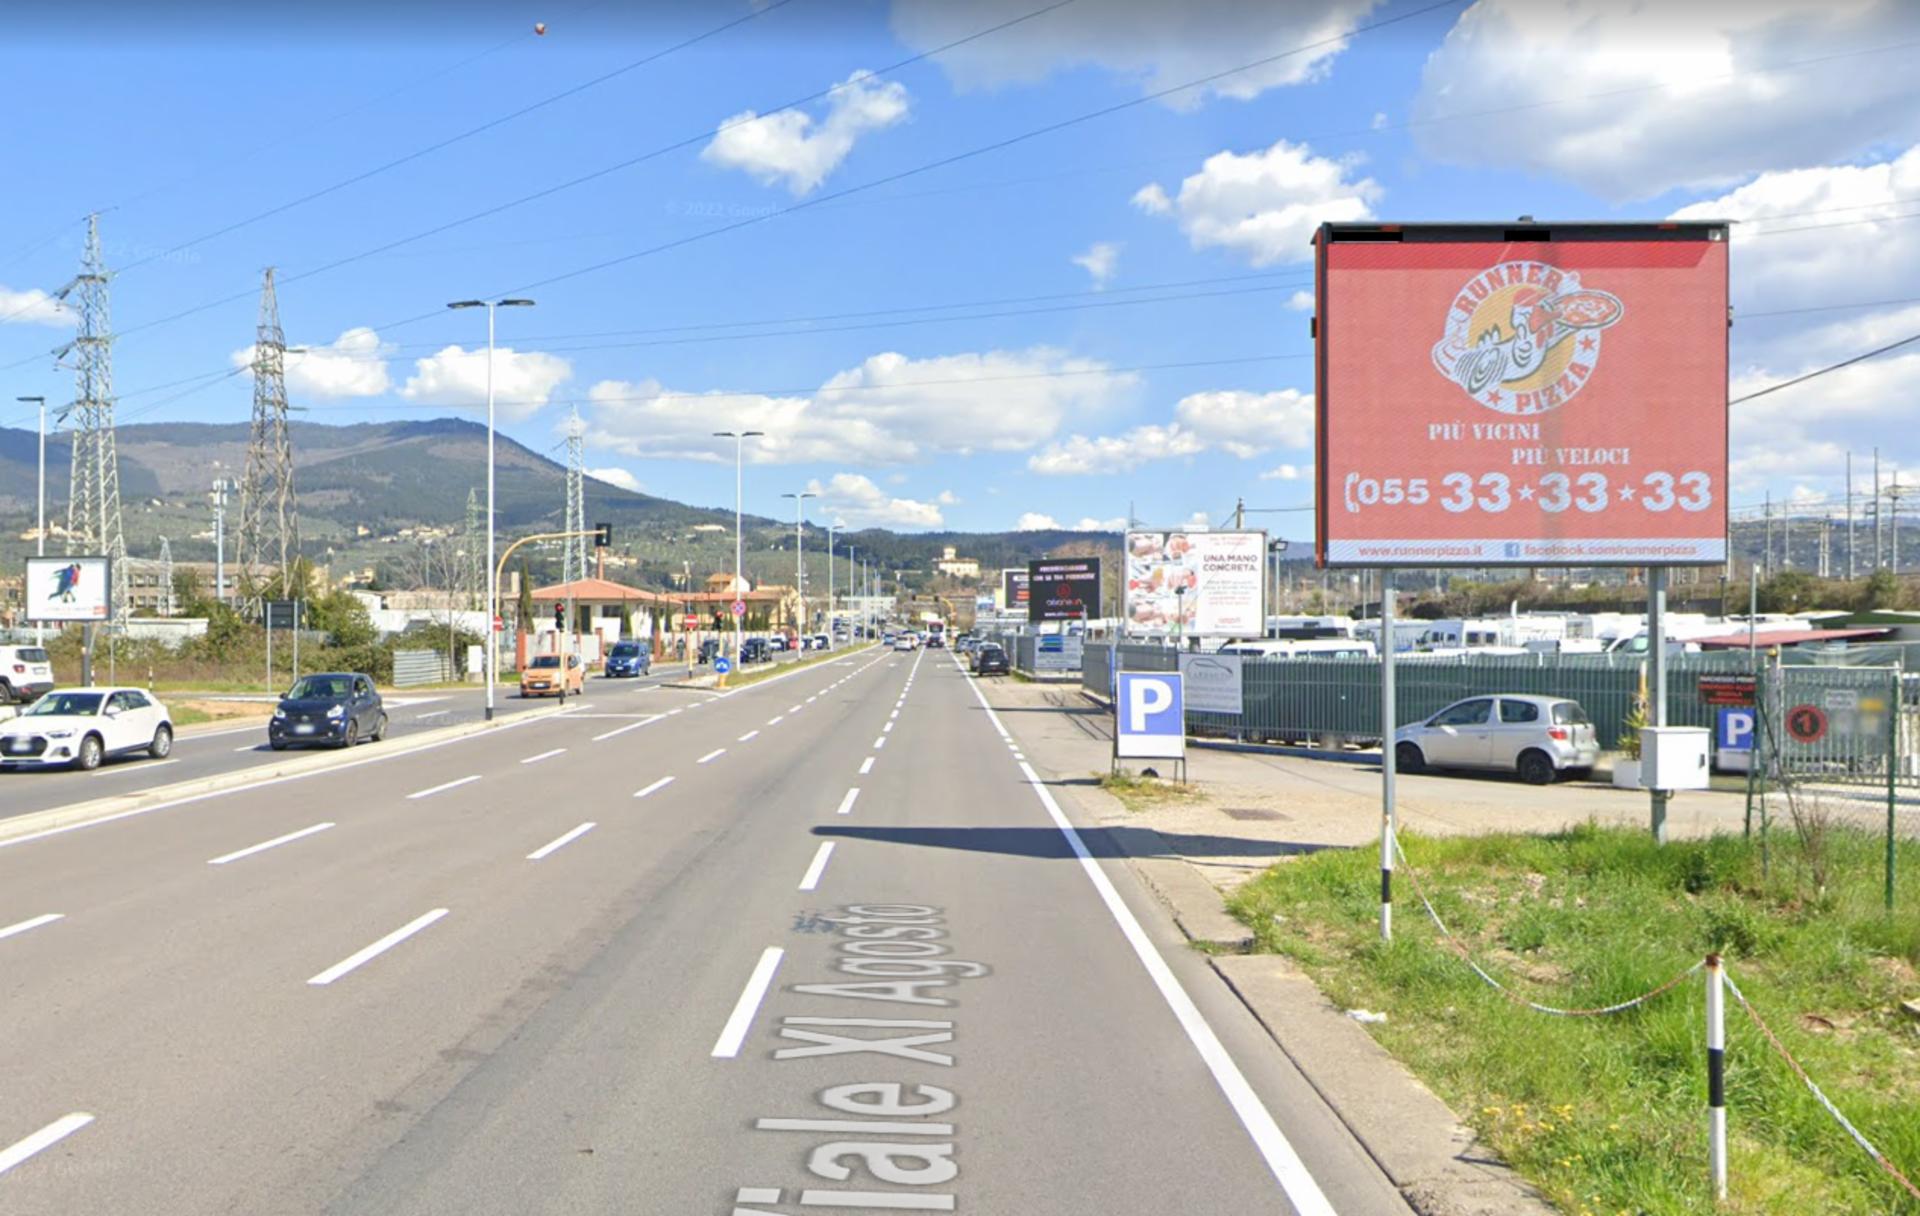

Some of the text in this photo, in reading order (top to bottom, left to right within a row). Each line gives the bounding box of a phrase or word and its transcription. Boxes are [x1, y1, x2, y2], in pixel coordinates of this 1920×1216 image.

[1455, 263, 1564, 317] RUNNER
[1515, 362, 1591, 412] PIZZA
[1428, 420, 1540, 440] PIÙ VICINI
[1511, 445, 1630, 465] PIÙ VELOCI
[1357, 471, 1713, 513] 055 33 33 33
[1203, 554, 1258, 562] UNA MANO
[1359, 545, 1483, 557] www.runnerpizza.it
[1524, 544, 1697, 557] facebook.com/runnerpizza
[1129, 678, 1173, 732] P
[1727, 713, 1754, 745] P
